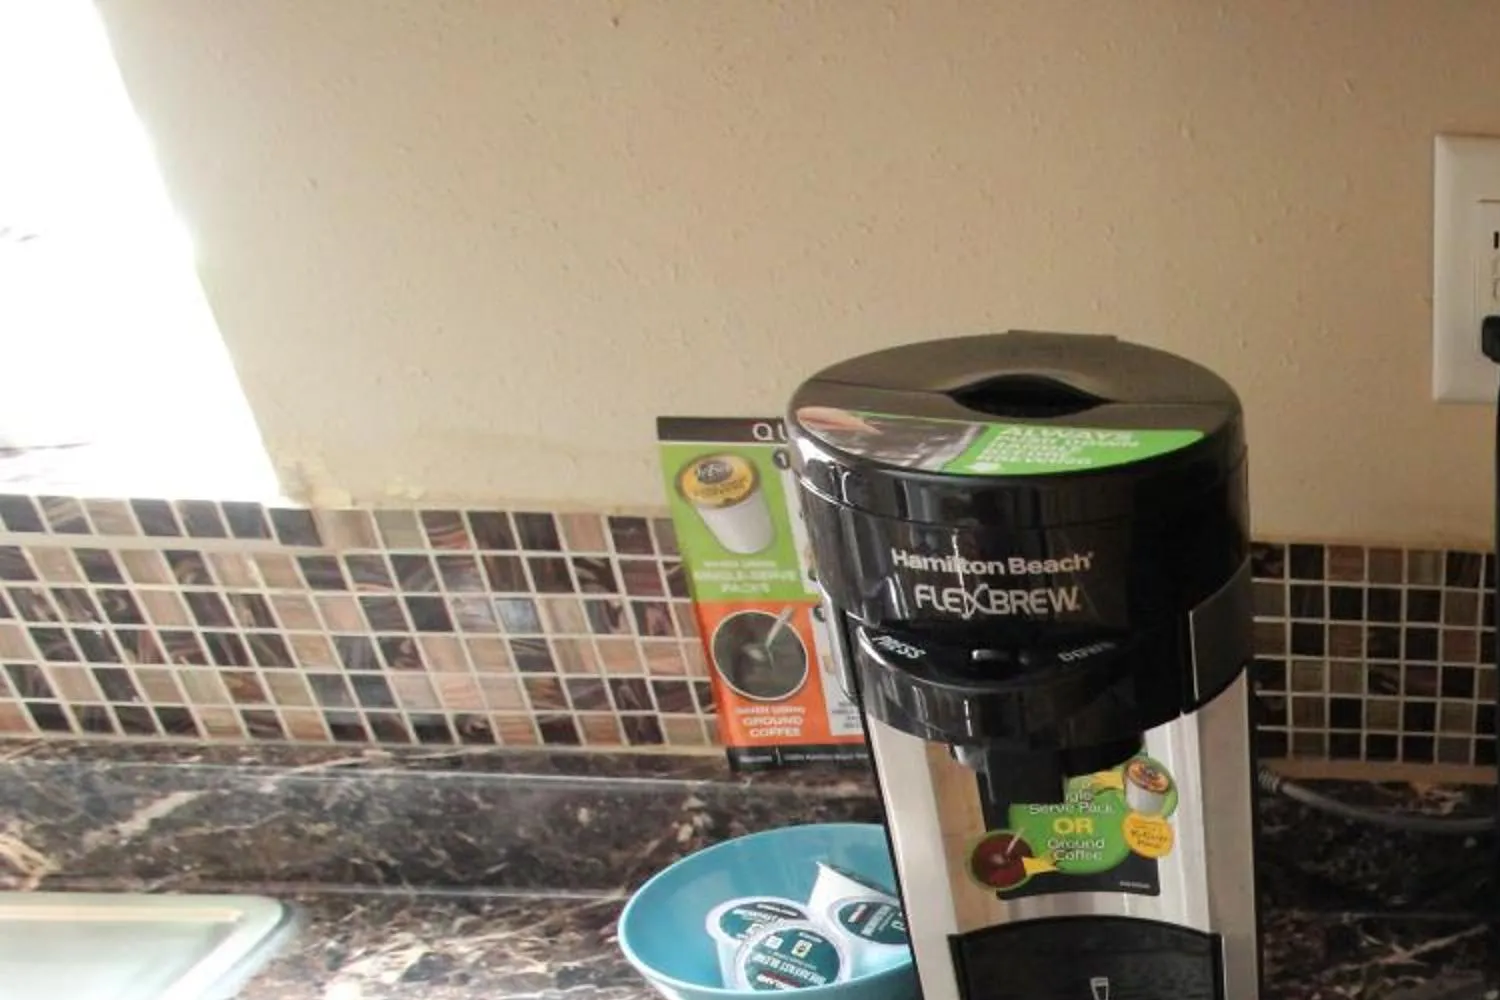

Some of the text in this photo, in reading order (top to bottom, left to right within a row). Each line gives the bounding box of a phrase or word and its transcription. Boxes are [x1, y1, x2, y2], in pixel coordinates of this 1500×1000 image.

[891, 548, 1093, 575] Hamilton Beach
[913, 582, 1078, 620] FLEXBREW
[1029, 803, 1074, 815] Serve
[1053, 816, 1094, 835] OR
[1047, 838, 1105, 850] Ground
[1054, 849, 1103, 862] Coffee
